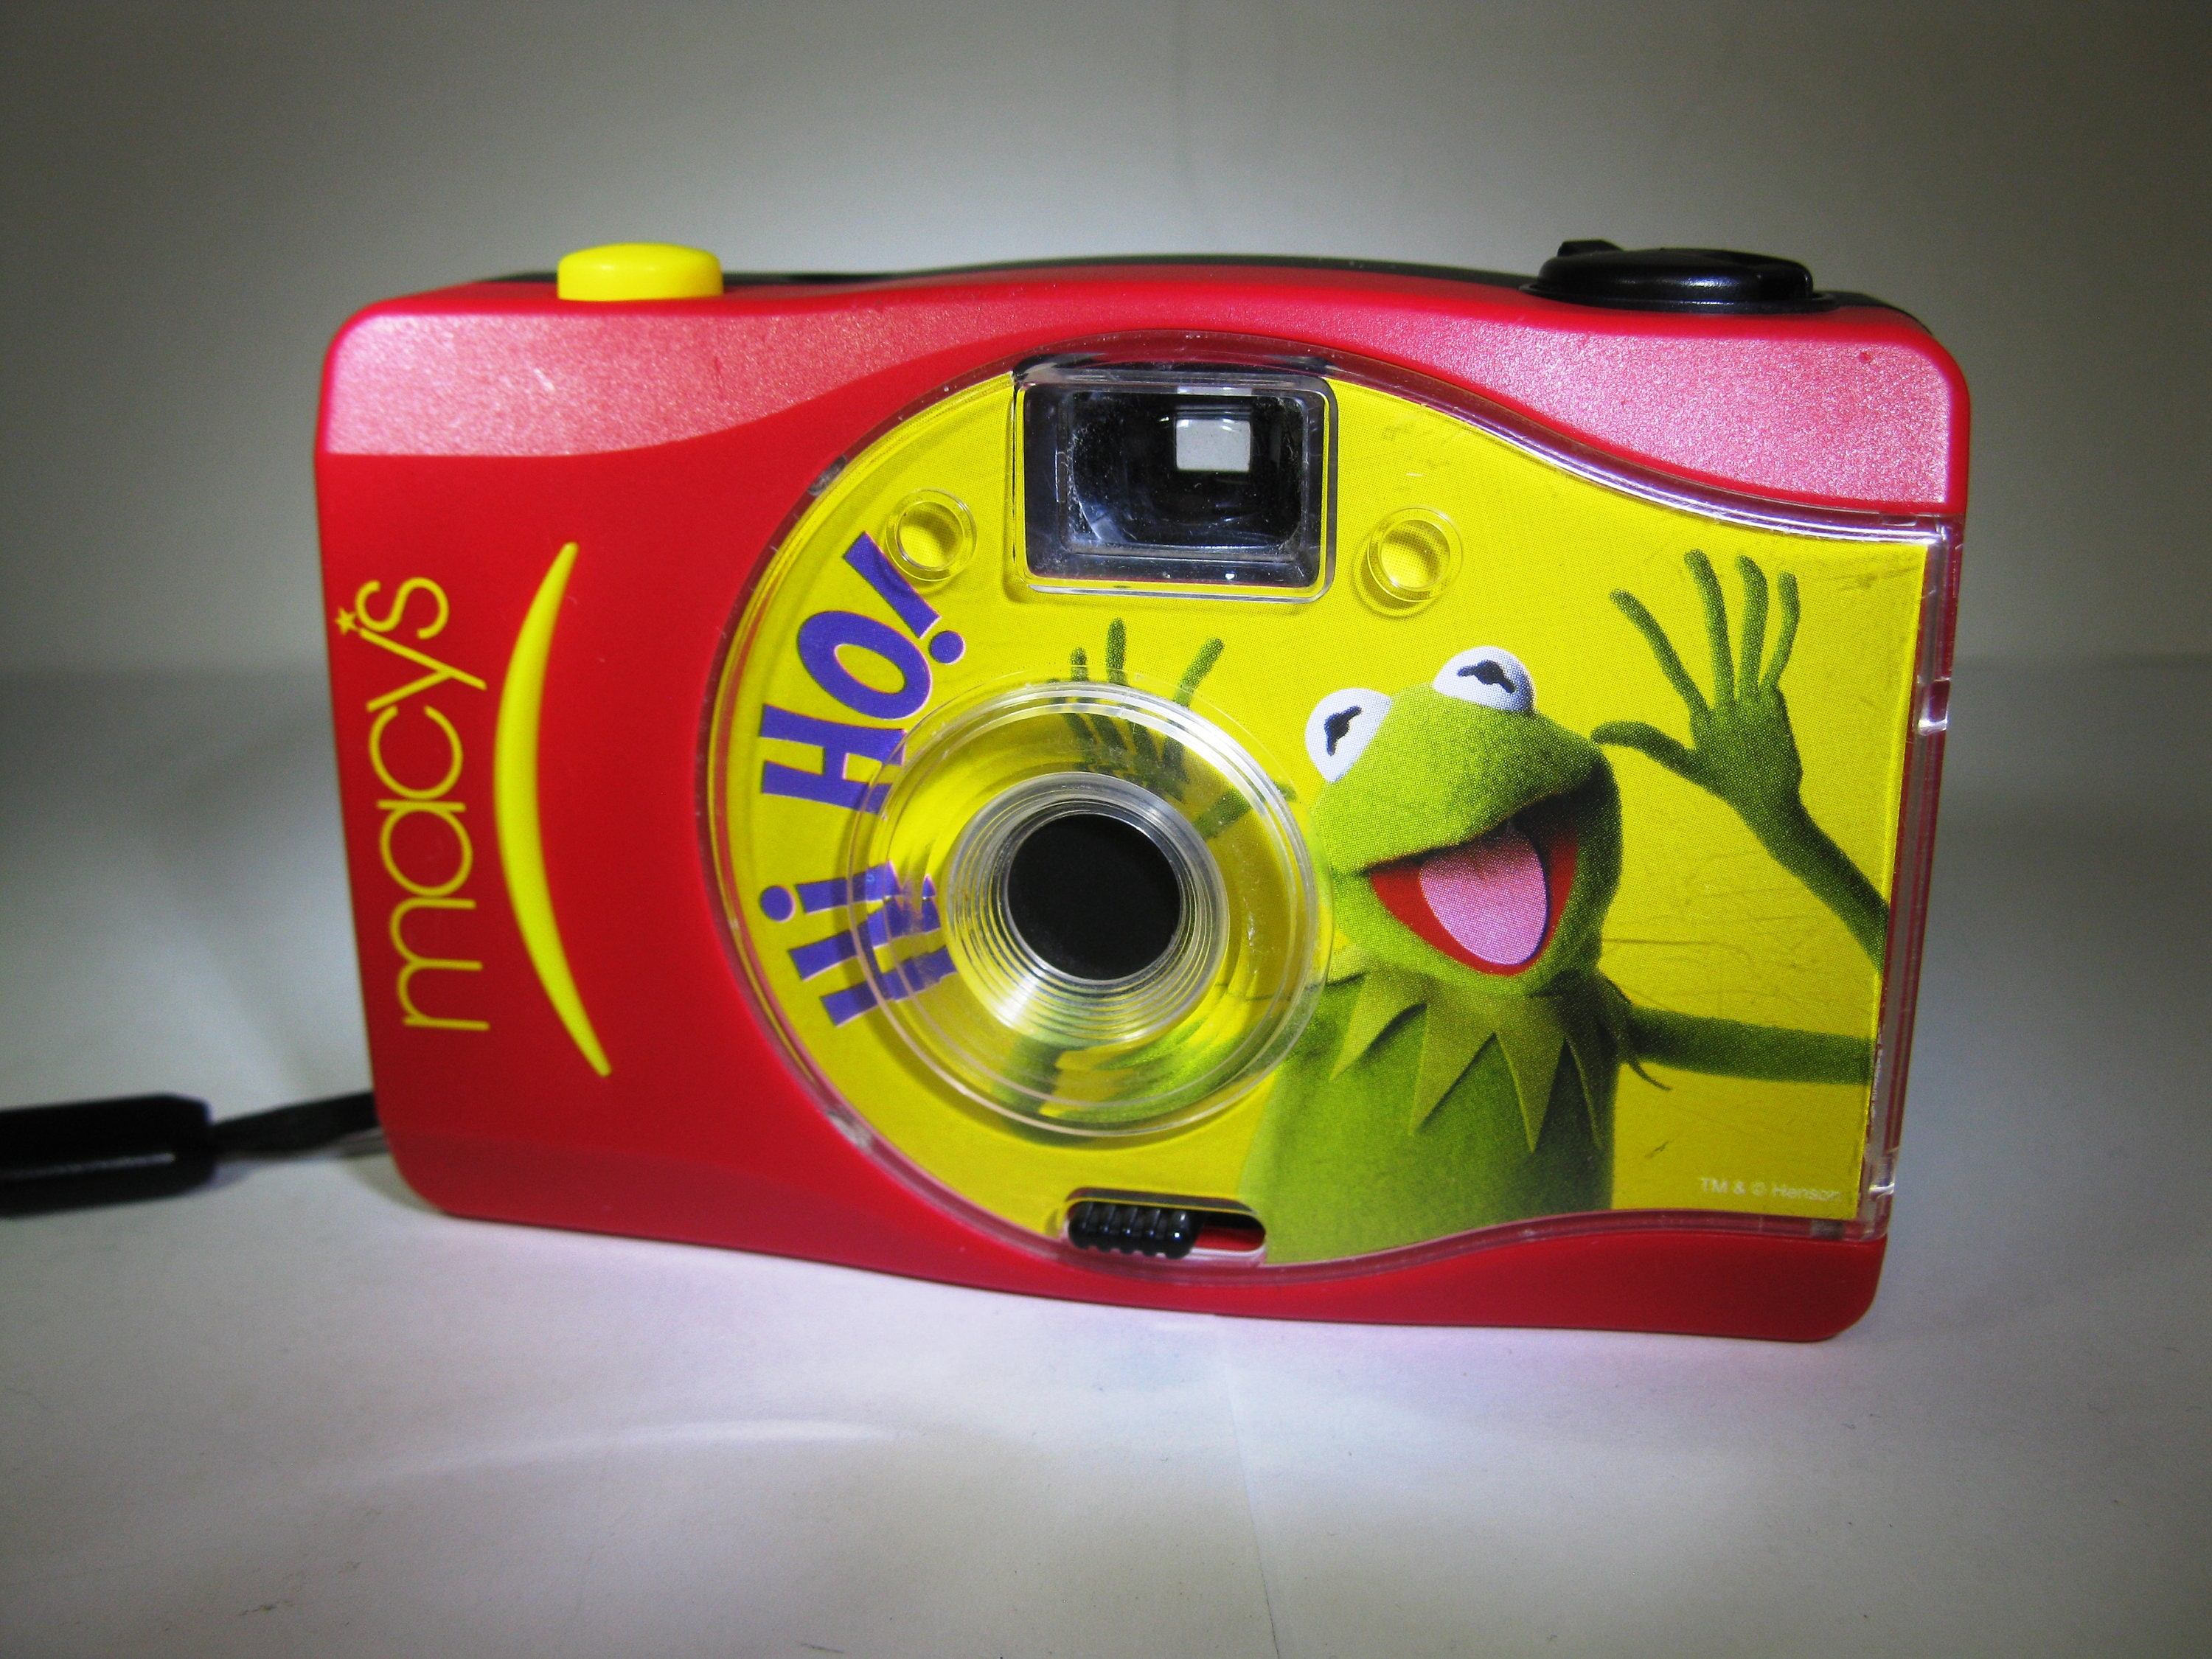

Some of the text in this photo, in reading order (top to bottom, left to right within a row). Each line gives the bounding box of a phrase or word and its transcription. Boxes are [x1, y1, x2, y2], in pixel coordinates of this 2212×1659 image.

[759, 531, 965, 817] HO!
[1701, 1178, 1728, 1194] TM
[1734, 1180, 1746, 1195] &
[1773, 1183, 1842, 1202] Henson
